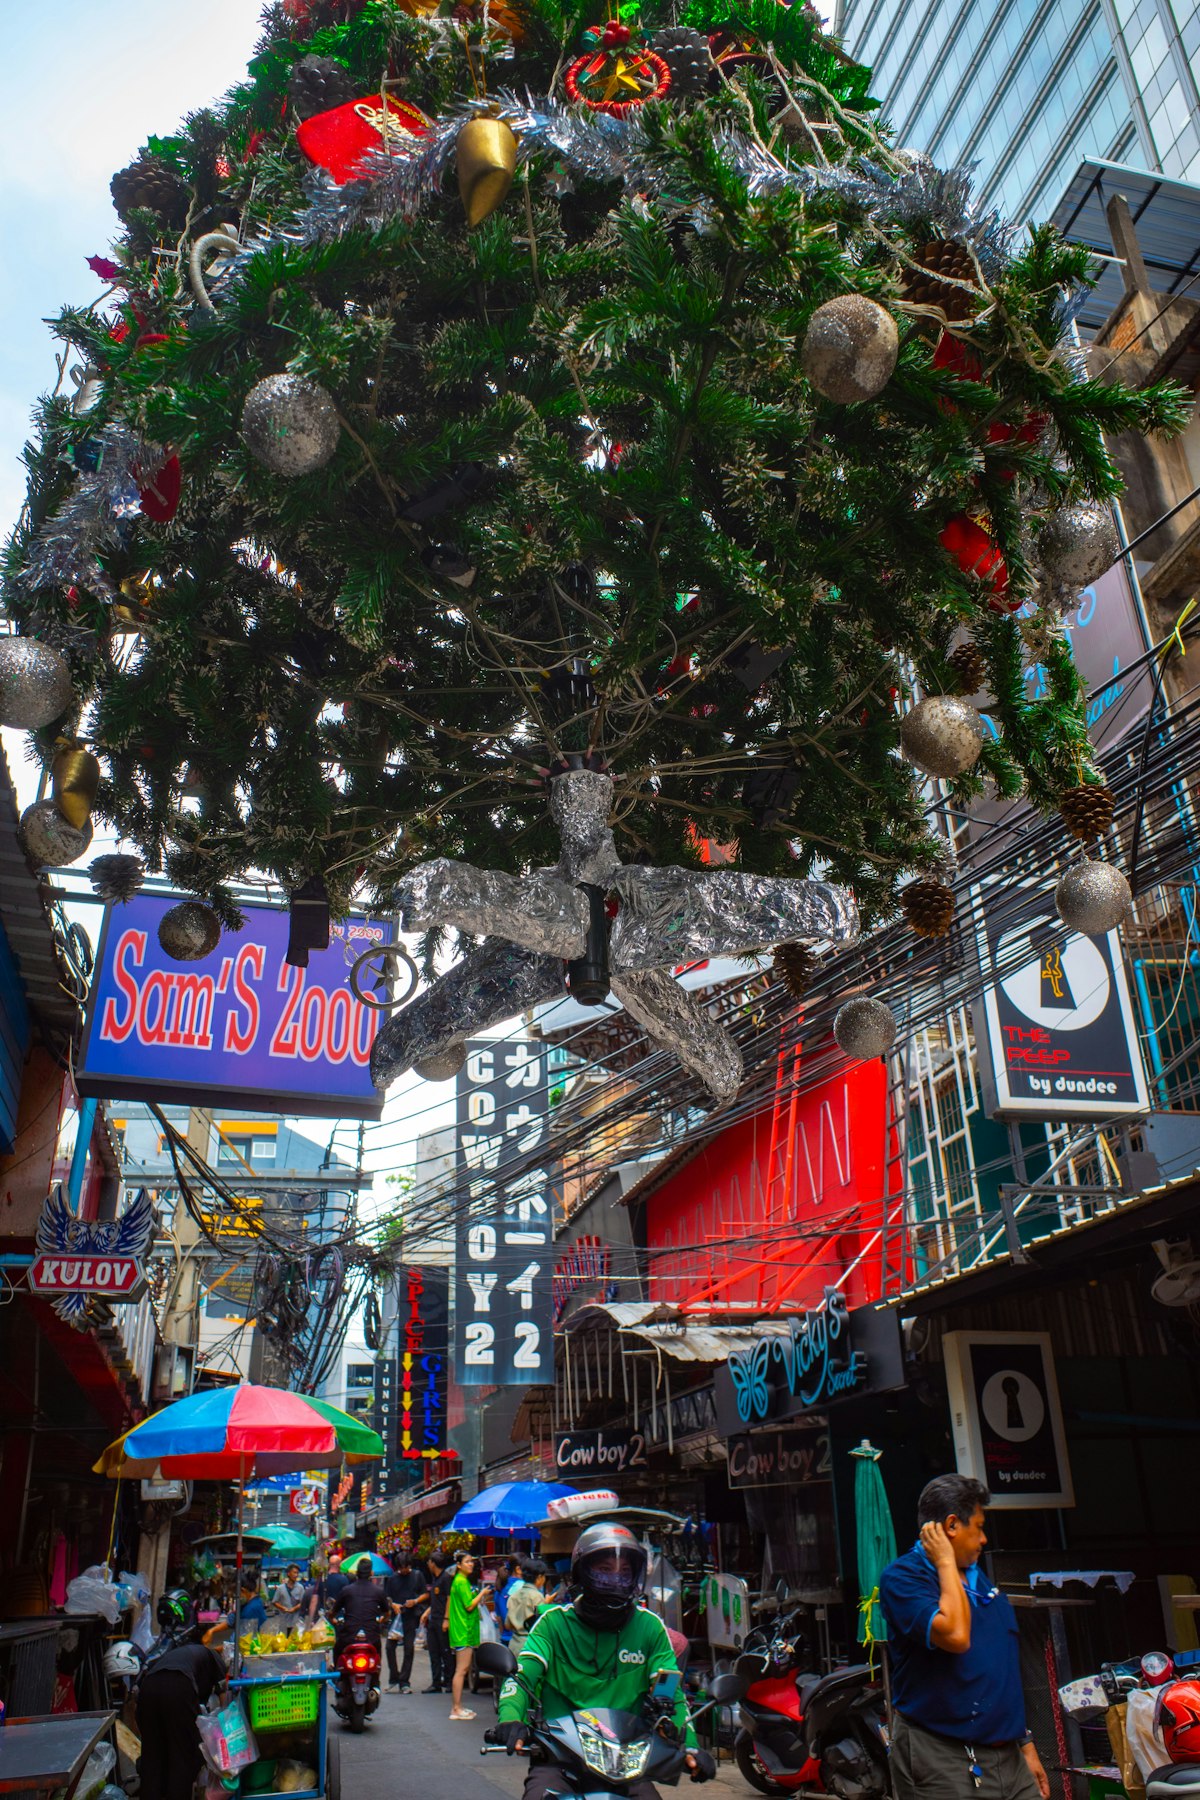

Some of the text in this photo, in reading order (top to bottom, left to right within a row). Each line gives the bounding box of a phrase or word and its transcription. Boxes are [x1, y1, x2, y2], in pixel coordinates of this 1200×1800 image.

[100, 928, 380, 1067] Sam'S 2000
[1003, 1025, 1051, 1044] THE
[1006, 1047, 1071, 1065] PEEP
[1028, 1074, 1118, 1095] by dundee
[40, 1260, 131, 1286] KULOV
[404, 1267, 442, 1446] SPICE GIRLS
[629, 1434, 648, 1466] 2
[998, 1470, 1047, 1483] by dundee
[618, 1649, 646, 1665] Grab
